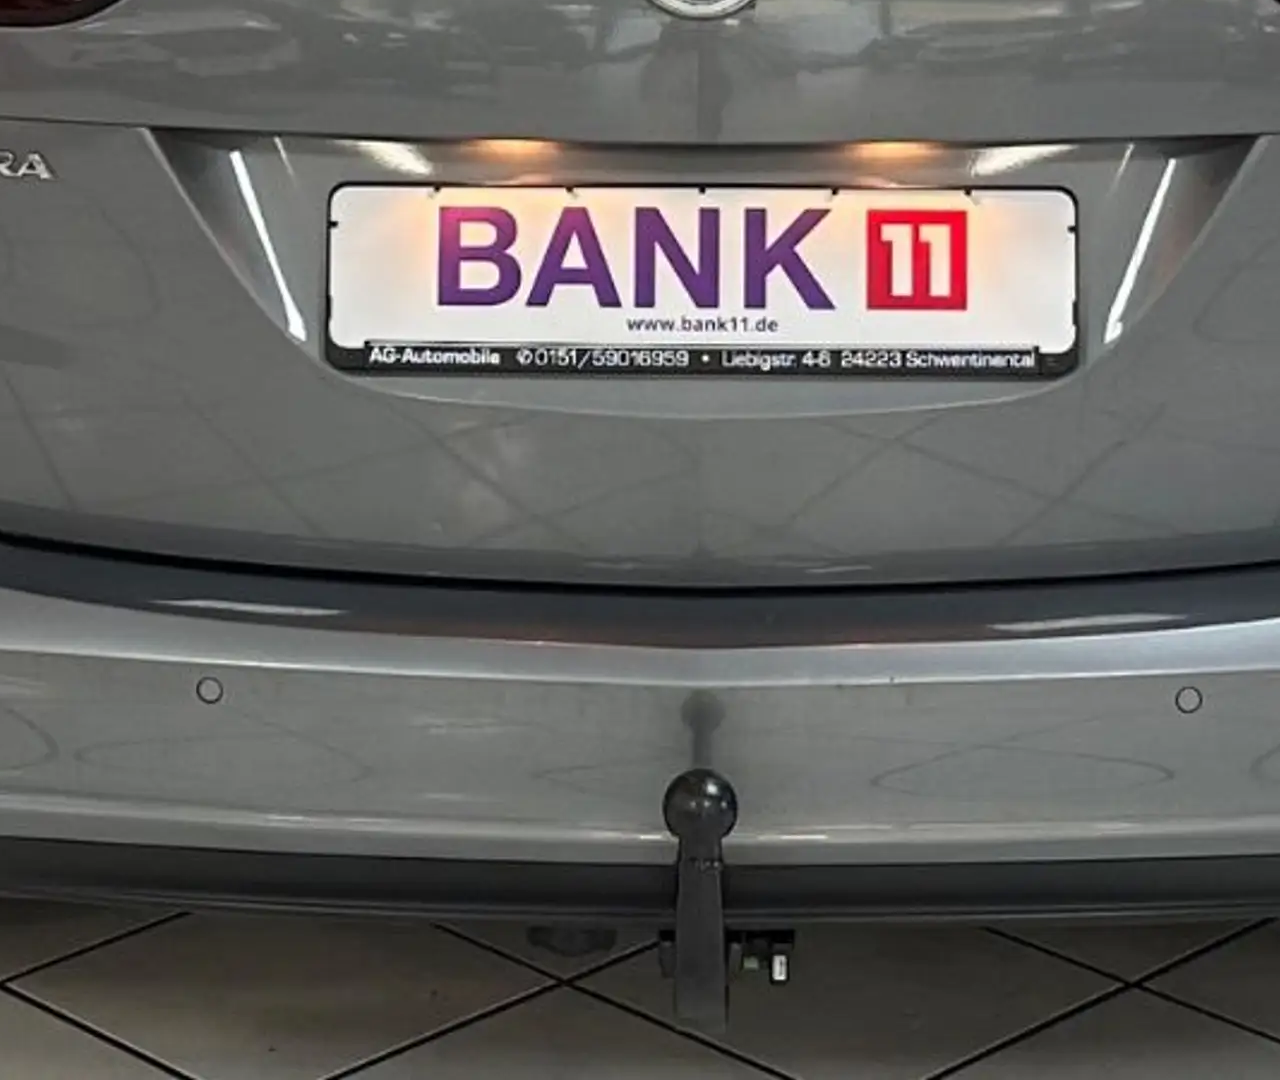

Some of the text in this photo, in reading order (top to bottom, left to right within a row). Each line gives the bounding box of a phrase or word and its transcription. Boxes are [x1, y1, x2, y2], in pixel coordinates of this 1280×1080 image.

[437, 206, 956, 310] BANK 11
[627, 316, 779, 334] www.bank11.de
[369, 347, 501, 365] AG-Automobile
[840, 350, 902, 368] 24223
